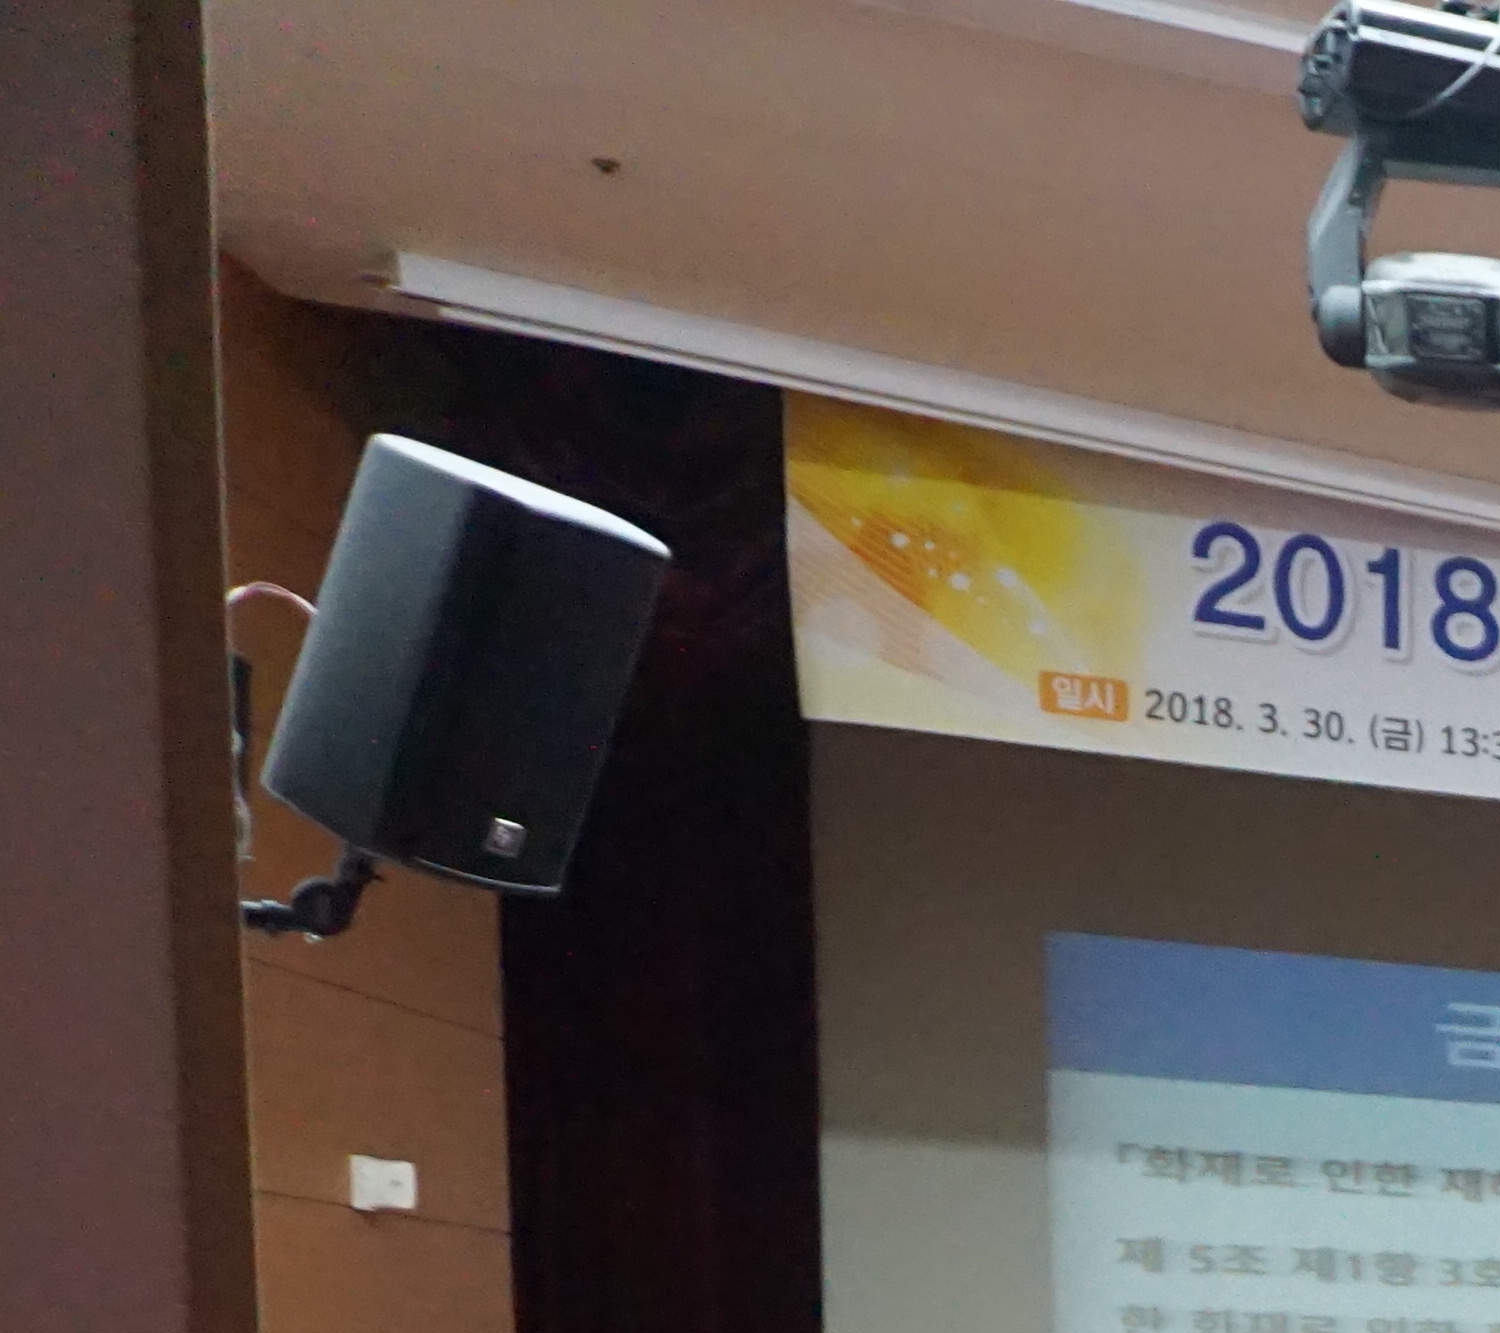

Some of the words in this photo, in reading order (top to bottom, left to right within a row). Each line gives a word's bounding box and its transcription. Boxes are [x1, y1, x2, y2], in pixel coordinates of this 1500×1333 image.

[1051, 675, 1117, 715] 일시
[1144, 688, 1243, 731] 2018.
[1258, 702, 1288, 737] 3.
[1303, 708, 1355, 745] 30.
[1369, 713, 1425, 755] (금)
[1321, 1157, 1418, 1199] 인한
[1117, 1236, 1166, 1275] 제
